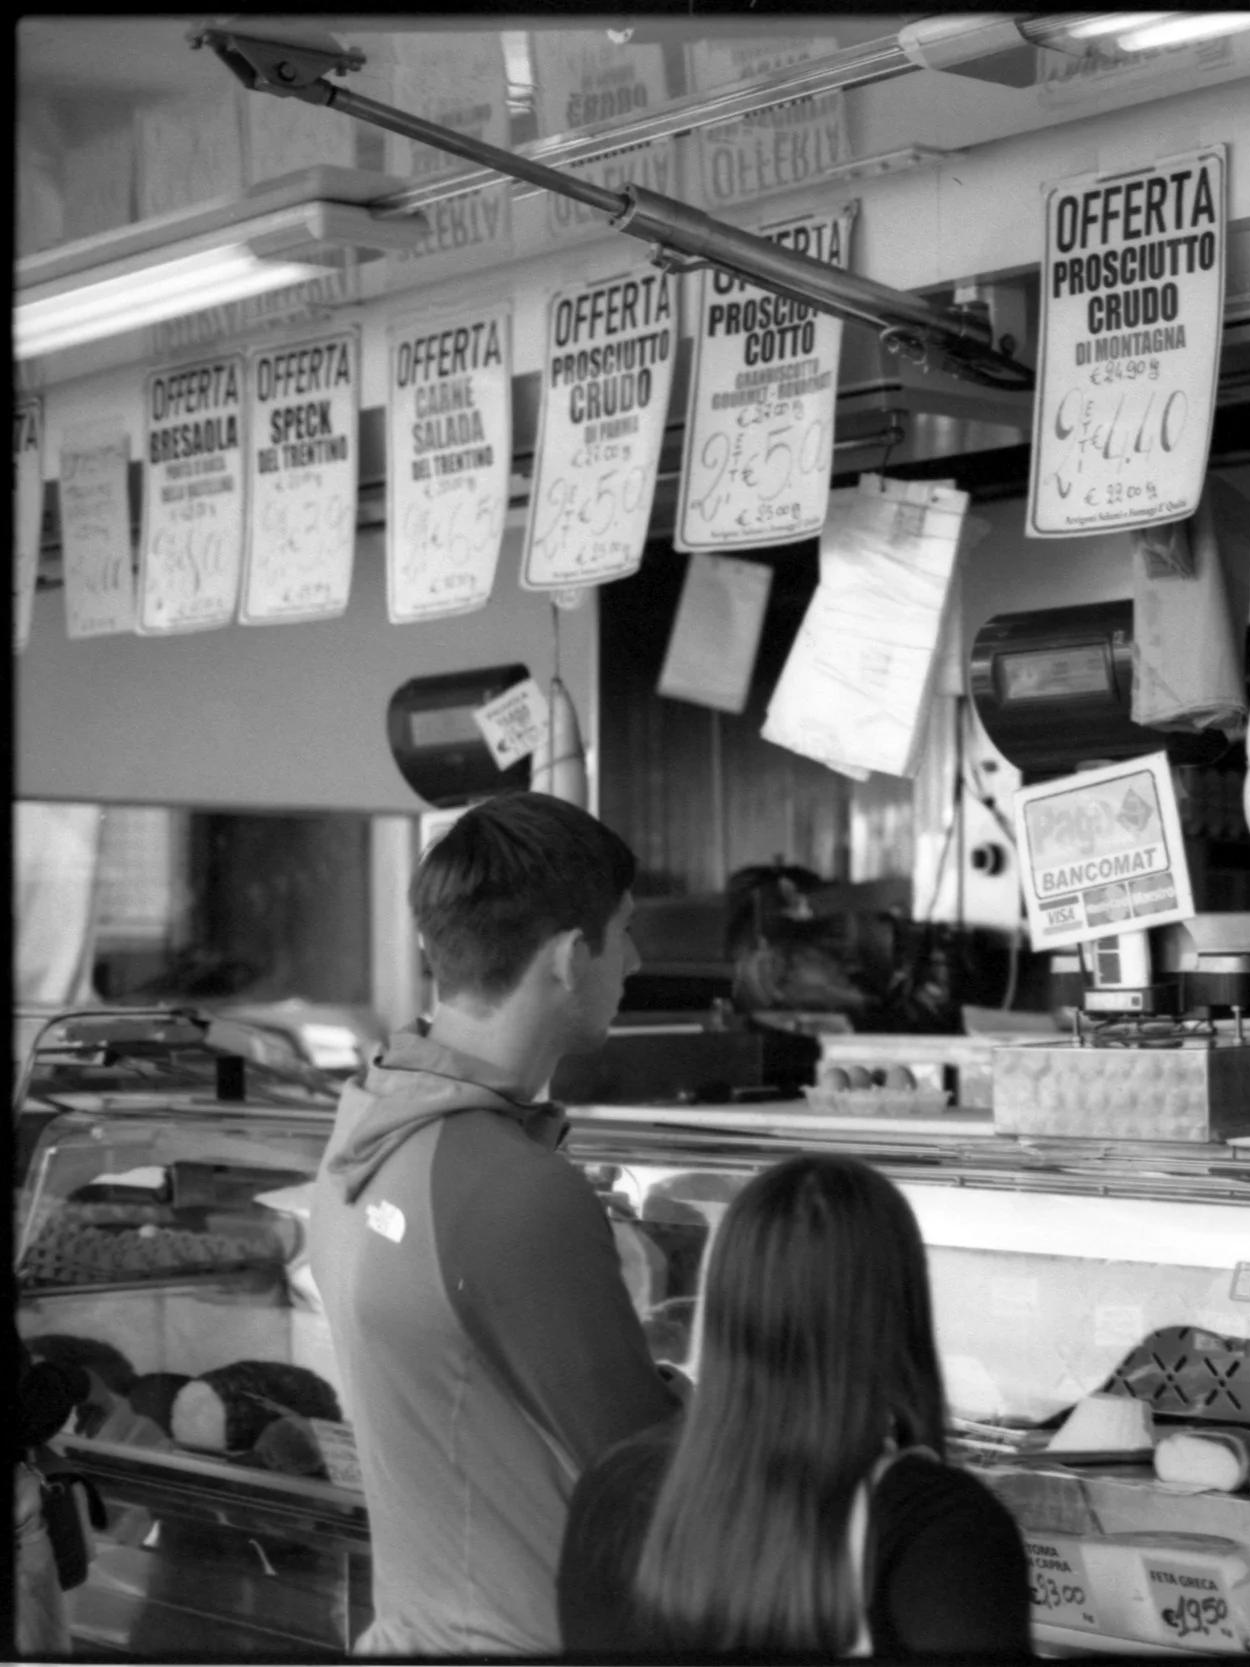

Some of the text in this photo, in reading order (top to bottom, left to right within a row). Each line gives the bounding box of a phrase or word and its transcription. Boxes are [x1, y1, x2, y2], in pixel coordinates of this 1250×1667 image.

[1055, 166, 1216, 254] OFFERTA
[1052, 231, 1216, 299] PROSCIUTTO
[555, 273, 671, 348] OFFERTA
[1087, 282, 1179, 335] CRUDO
[396, 319, 502, 390] OFFERTA
[551, 329, 671, 388] PROSCIUTTO
[744, 320, 815, 366] COTTO
[1075, 324, 1187, 367] DI MONTAGNA
[152, 362, 240, 422] OFFERTA
[257, 341, 352, 402] OFFERTA
[569, 368, 652, 424] CRUDO
[150, 415, 240, 464] BRESAOLA
[270, 400, 333, 445] SPECK
[412, 407, 486, 456] SALADA
[1042, 847, 1157, 892] BANCOMAT
[1047, 907, 1076, 925] VISA
[1150, 1570, 1219, 1592] FETA GRECA
